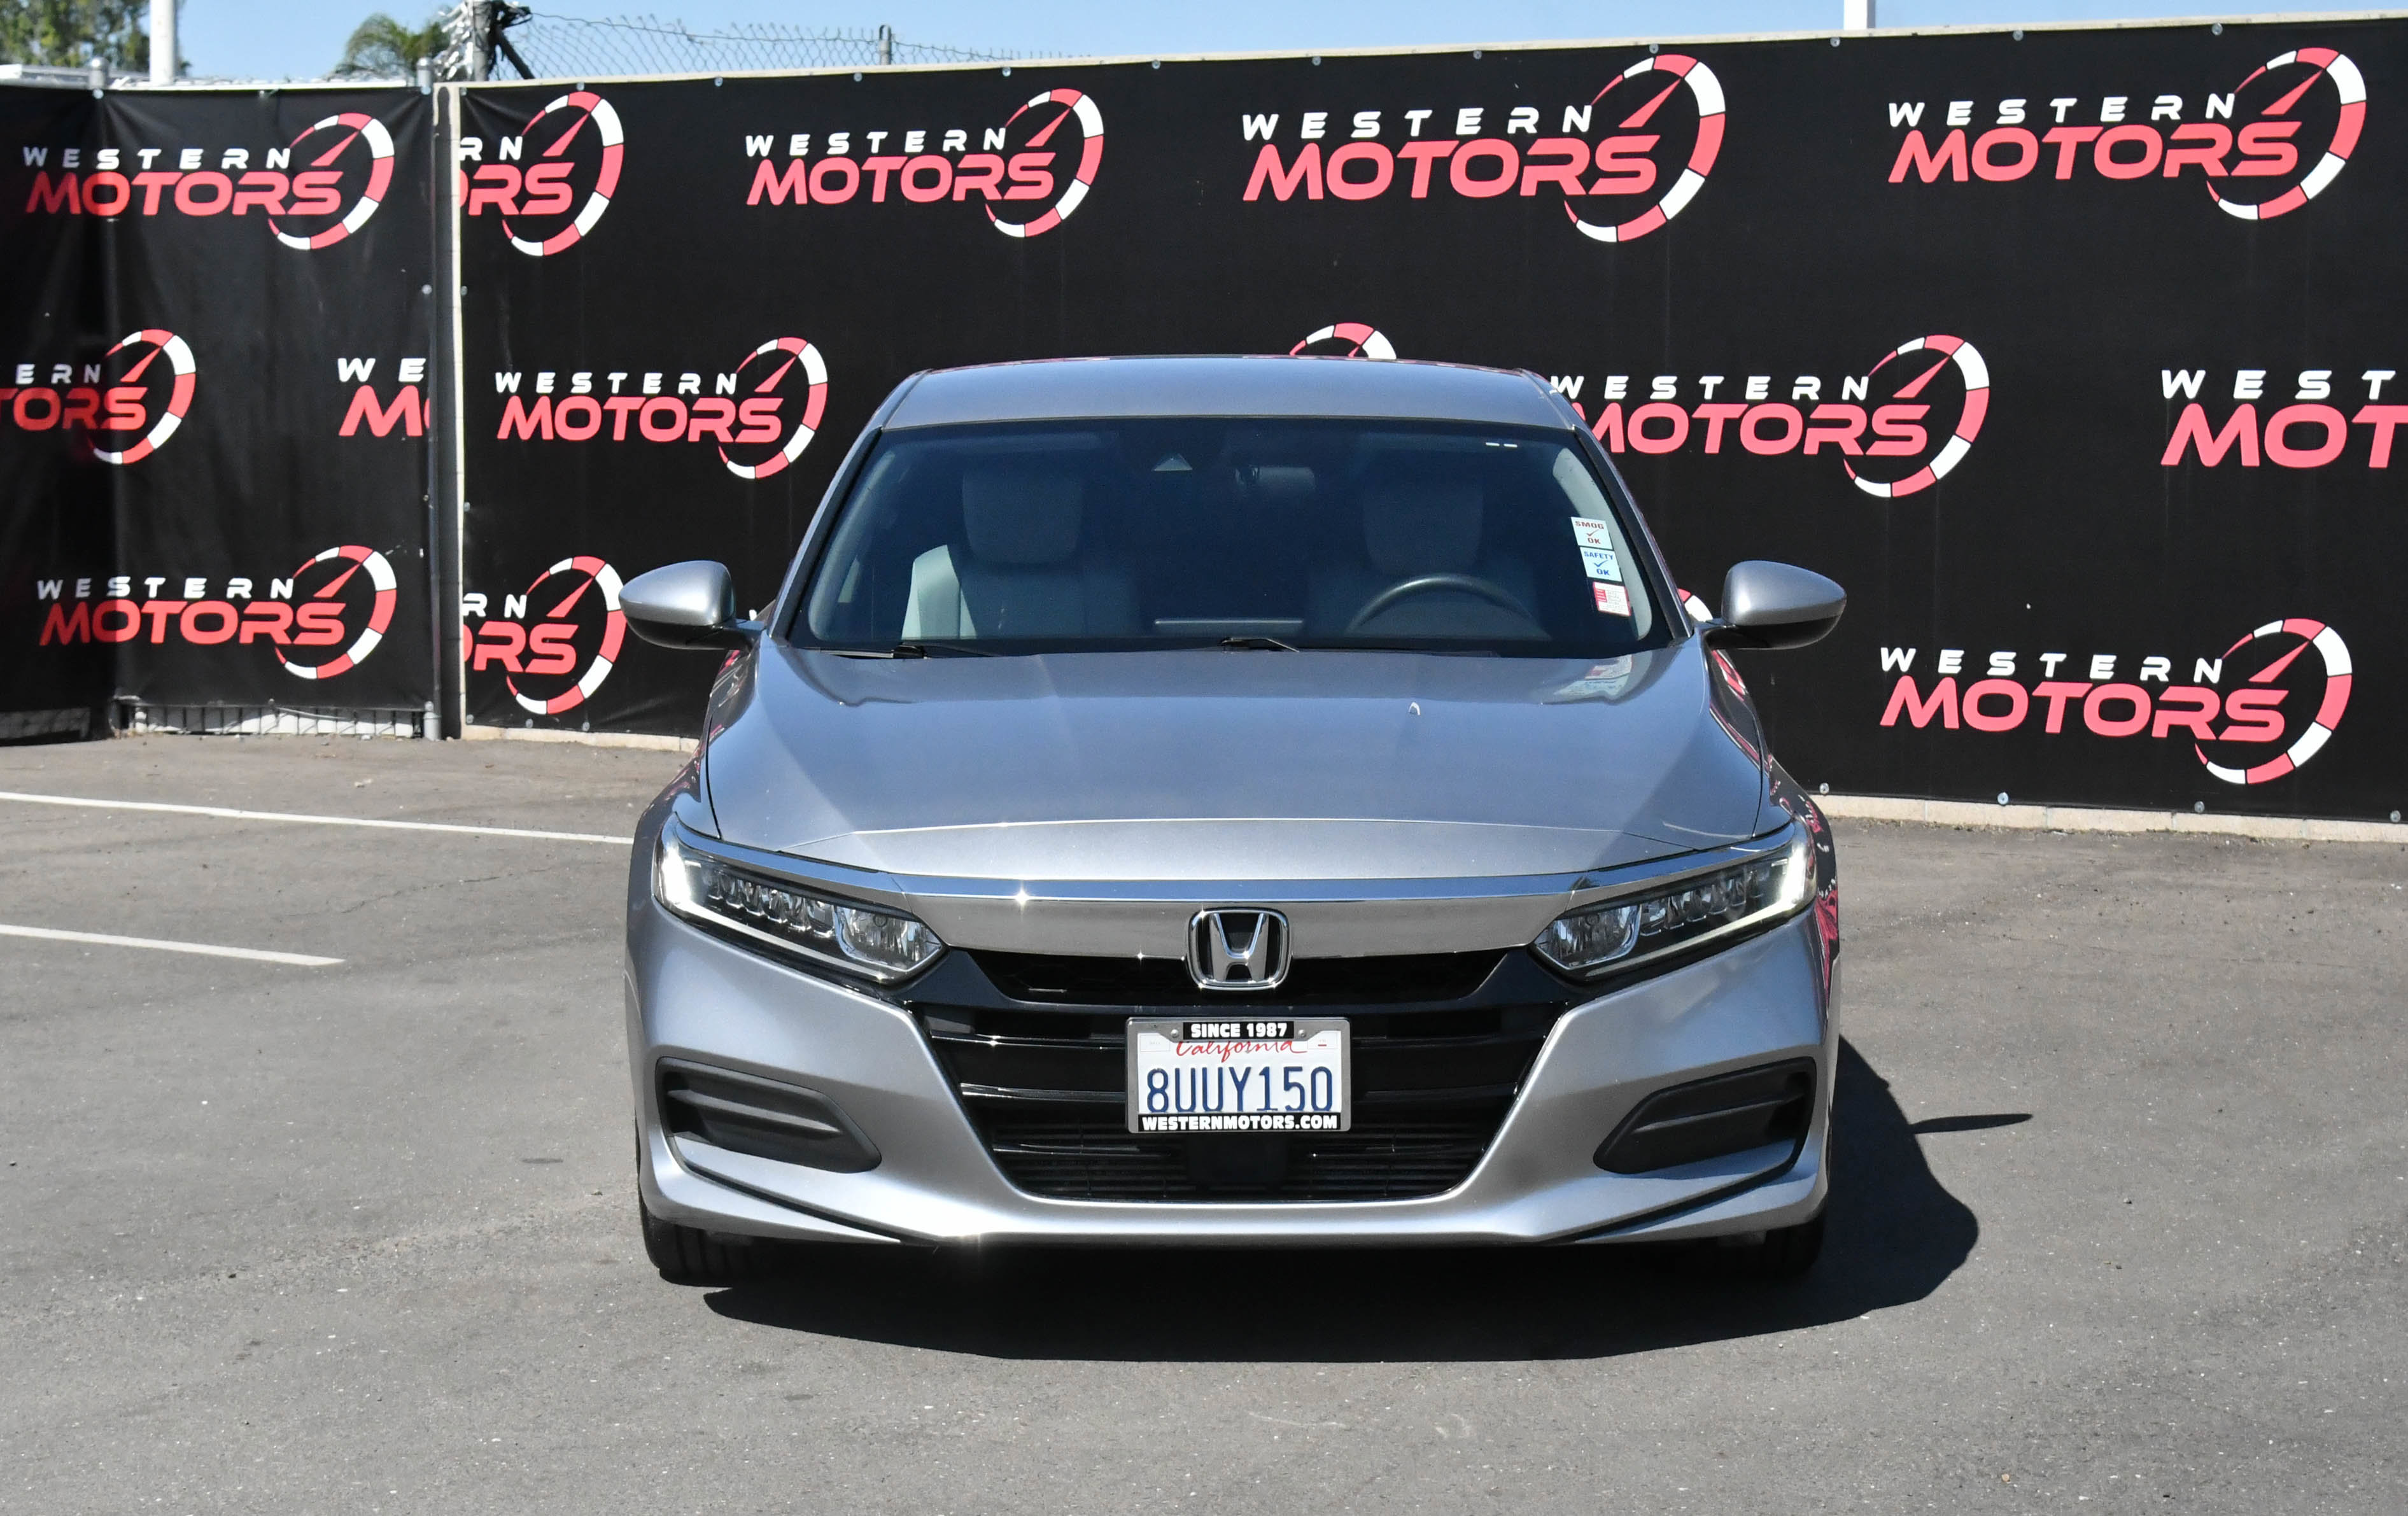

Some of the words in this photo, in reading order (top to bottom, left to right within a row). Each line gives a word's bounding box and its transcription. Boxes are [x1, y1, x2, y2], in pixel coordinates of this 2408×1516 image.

[1242, 104, 1593, 141] WESTERN
[1888, 93, 2235, 128] WESTERN
[24, 147, 290, 170] WESTERN
[745, 127, 1006, 158] WESTERN
[1888, 121, 2302, 183] MOTORS
[746, 152, 1056, 206] MOTORS
[1243, 134, 1660, 202] MOTORS
[26, 171, 343, 216] MOTORS
[460, 162, 575, 216] RS
[495, 372, 737, 395] WESTERN
[1550, 375, 1869, 401] WESTERN
[338, 384, 430, 437] M
[496, 395, 784, 444] MOTORS
[1575, 521, 1604, 530] SMOG
[1584, 551, 1614, 560] SAFETY
[37, 575, 293, 600] WESTERN
[40, 599, 346, 645] MOTORS
[463, 621, 579, 675] RS
[1880, 647, 2222, 684] WESTERN
[1880, 675, 2289, 743] MOTORS
[1190, 1023, 1241, 1038] SINCE
[1246, 1023, 1287, 1037] 1987
[1147, 1066, 1333, 1113] 8UUY150
[1142, 1115, 1337, 1130] WESTERNMOTORS.COM
